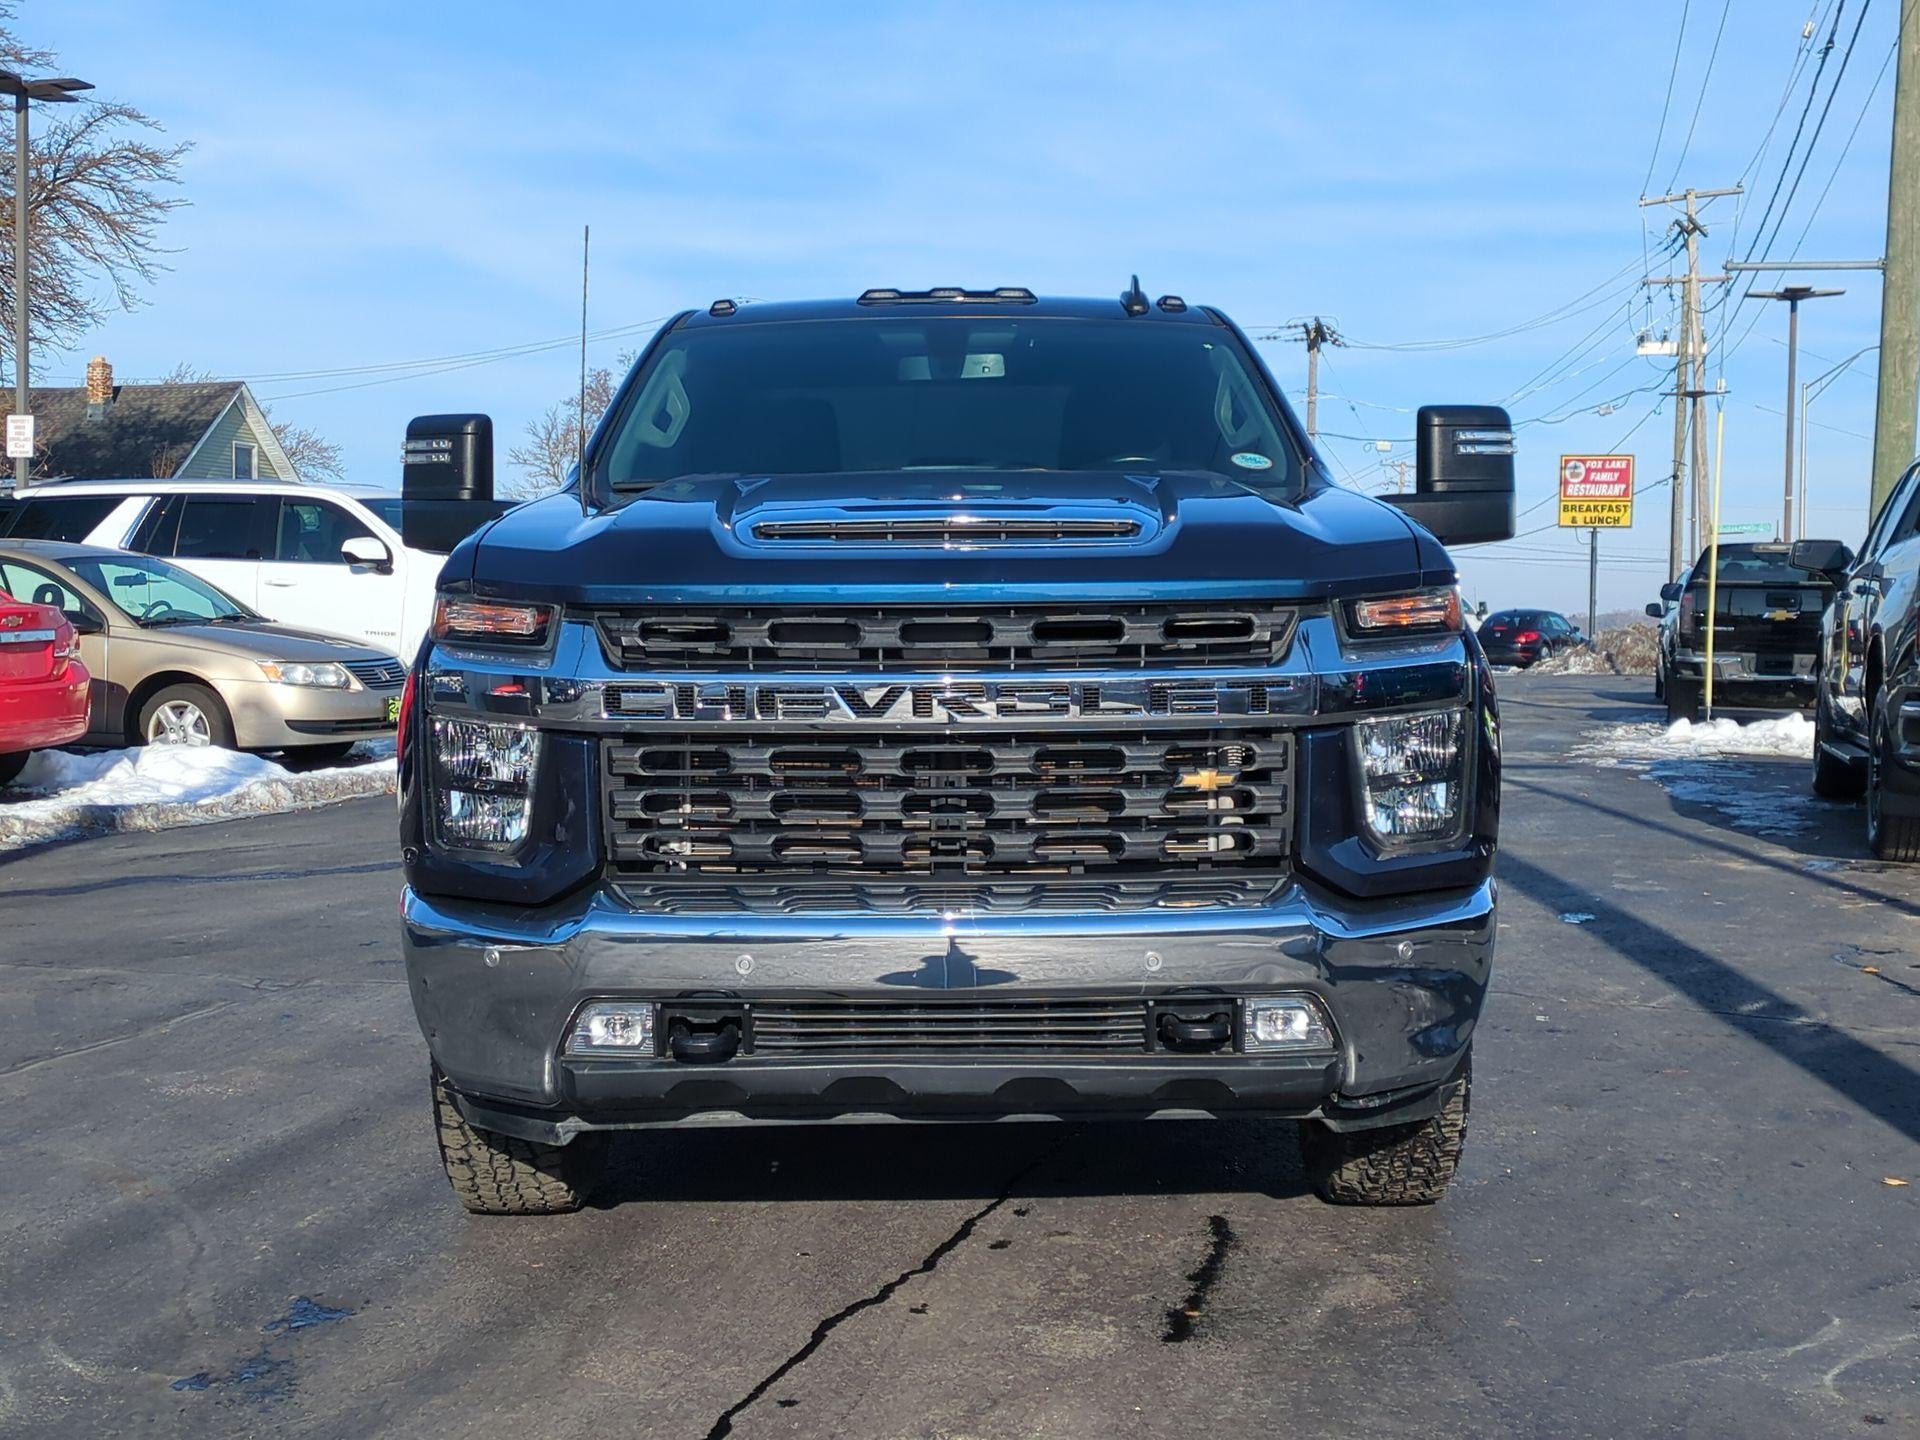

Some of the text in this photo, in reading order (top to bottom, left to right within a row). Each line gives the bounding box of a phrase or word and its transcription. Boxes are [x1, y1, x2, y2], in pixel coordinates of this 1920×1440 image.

[1586, 460, 1627, 469] FOX LAKE
[1590, 472, 1619, 481] FAMILY
[1566, 484, 1626, 496] RESTAURANT
[1563, 504, 1629, 513] BREAKFAST
[1571, 516, 1620, 524] & LUNCH
[601, 679, 1294, 720] CHEVROLET
